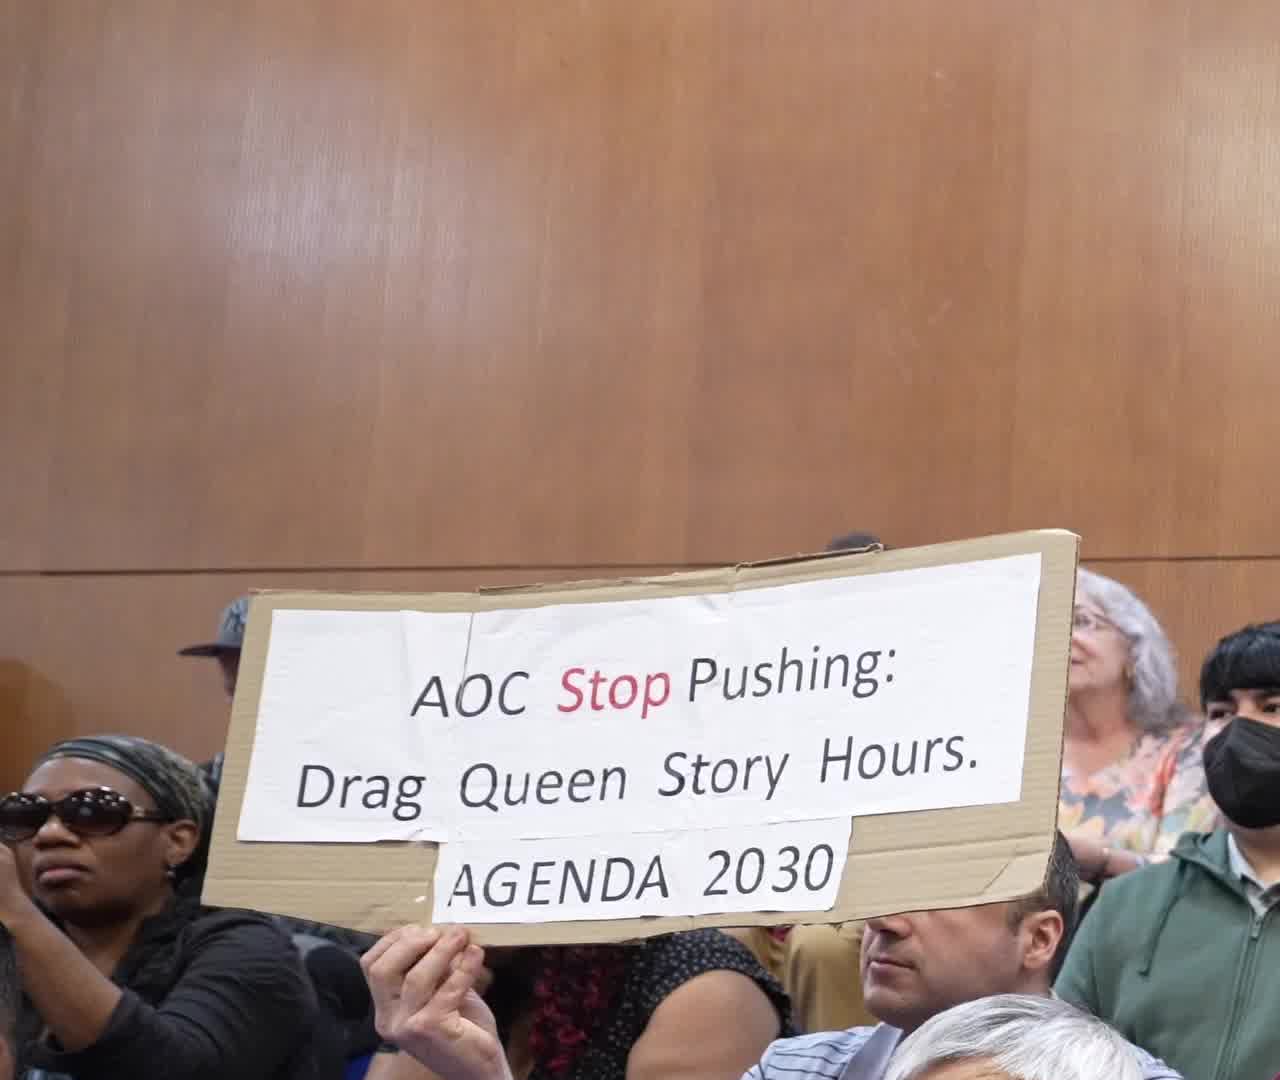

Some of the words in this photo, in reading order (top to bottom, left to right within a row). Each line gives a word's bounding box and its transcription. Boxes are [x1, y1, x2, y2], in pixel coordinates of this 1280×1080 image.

[409, 670, 530, 718] AOC
[556, 666, 671, 719] Stop
[688, 646, 899, 703] Pushing:
[296, 763, 426, 821] Drag
[458, 761, 627, 813] Queen
[657, 748, 790, 801] Story
[819, 734, 978, 784] Hours.
[447, 854, 670, 907] AGENDA
[701, 843, 836, 897] 2030
